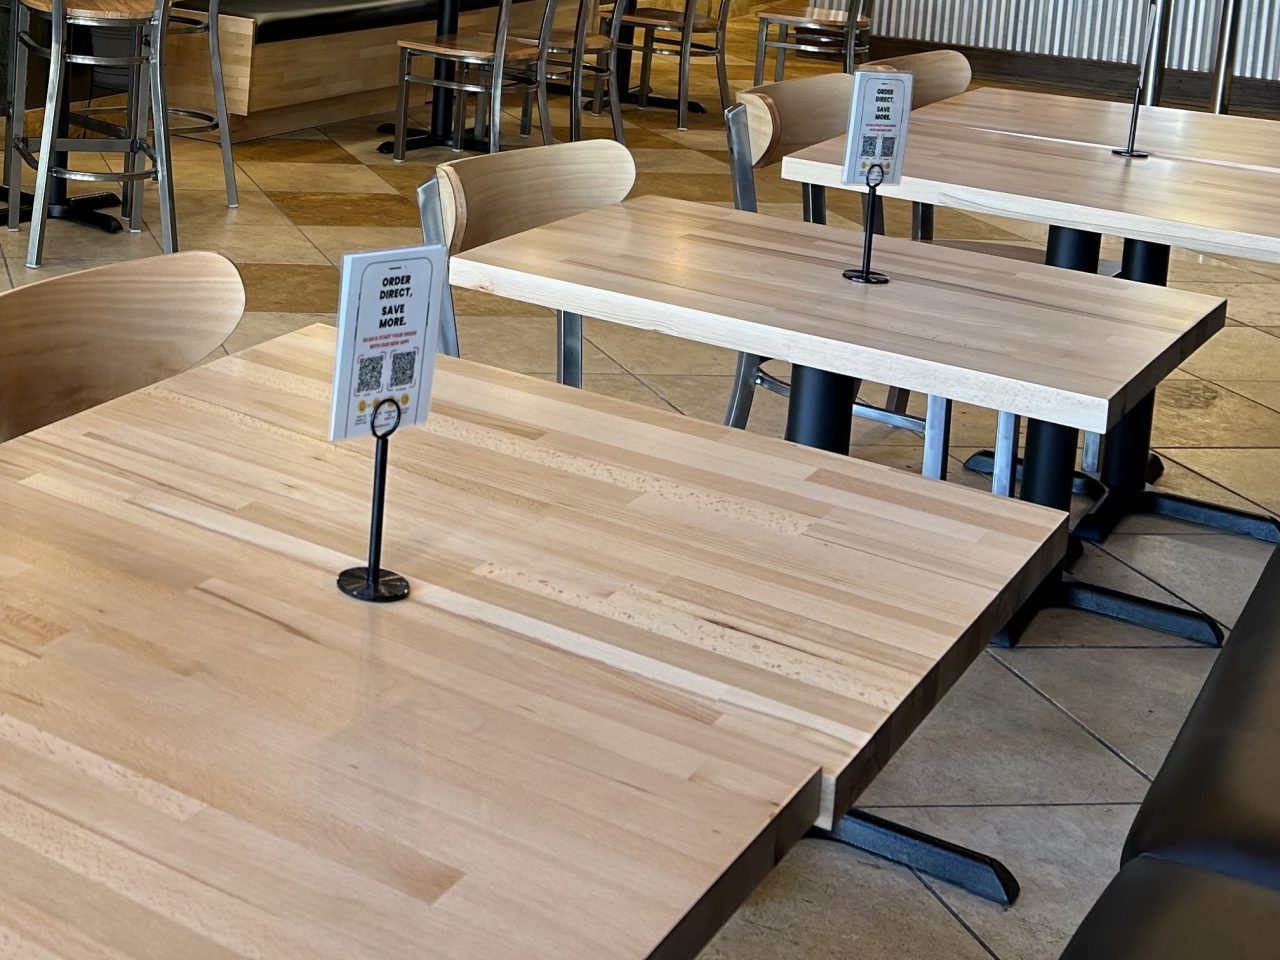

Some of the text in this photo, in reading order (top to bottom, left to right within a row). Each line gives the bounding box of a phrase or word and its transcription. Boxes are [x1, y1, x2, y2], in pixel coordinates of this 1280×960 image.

[382, 275, 411, 287] ORDER
[379, 287, 413, 300] DIRECT,
[382, 304, 405, 316] SAVE
[379, 316, 407, 328] MORE.
